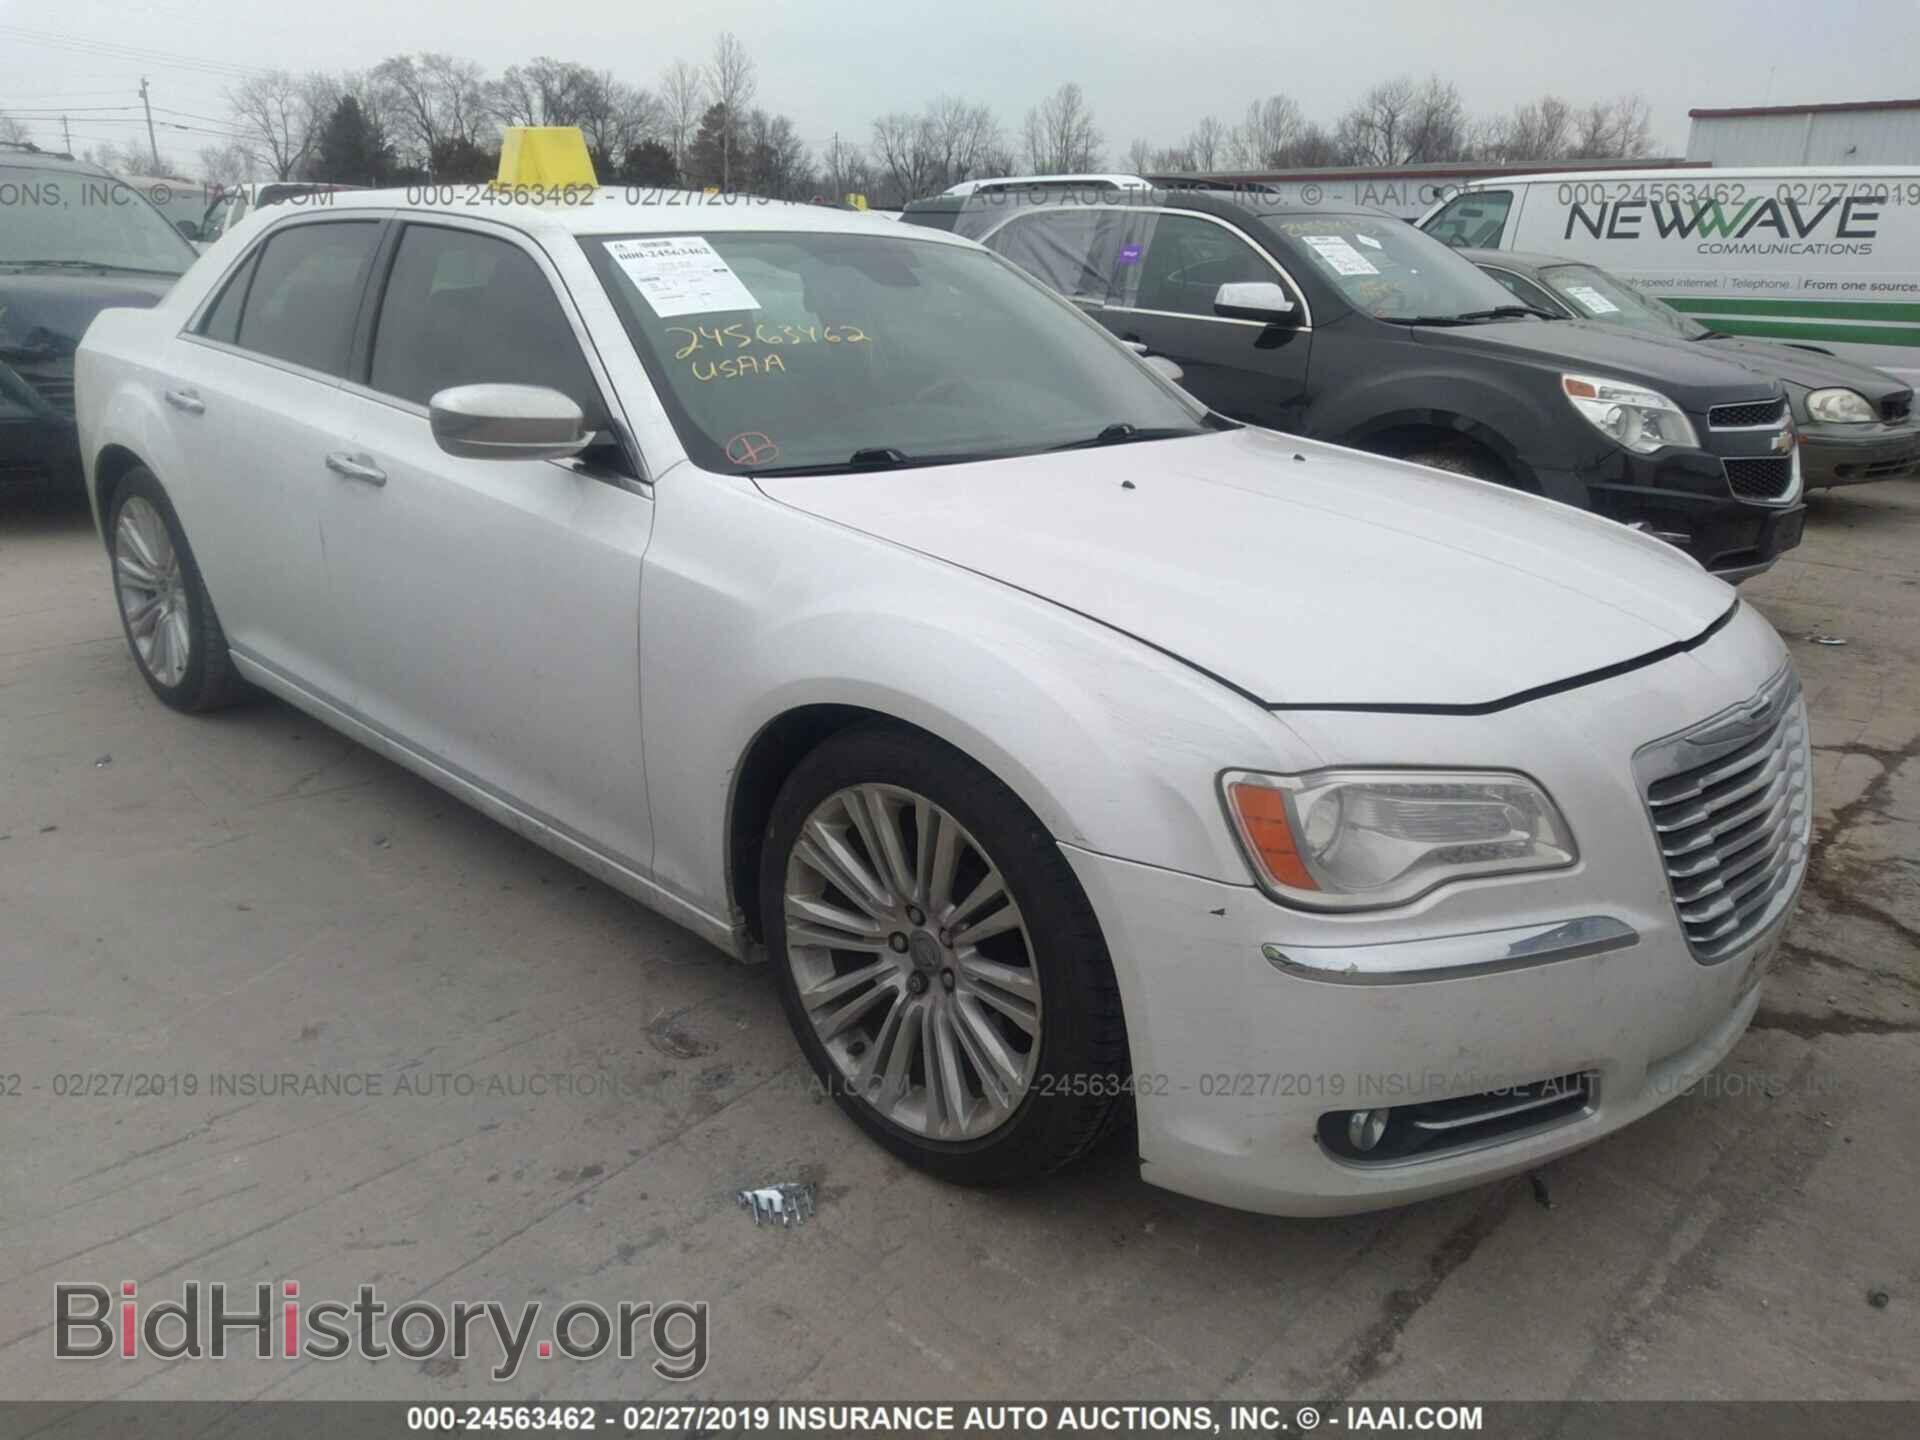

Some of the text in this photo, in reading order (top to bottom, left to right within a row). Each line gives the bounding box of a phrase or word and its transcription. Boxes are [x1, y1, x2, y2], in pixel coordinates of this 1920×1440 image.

[1697, 242, 1873, 256] COMMUNICATIONS
[1804, 279, 1838, 290] From
[1841, 282, 1866, 292] one
[665, 324, 873, 360] 24563462
[692, 354, 786, 381] USAA
